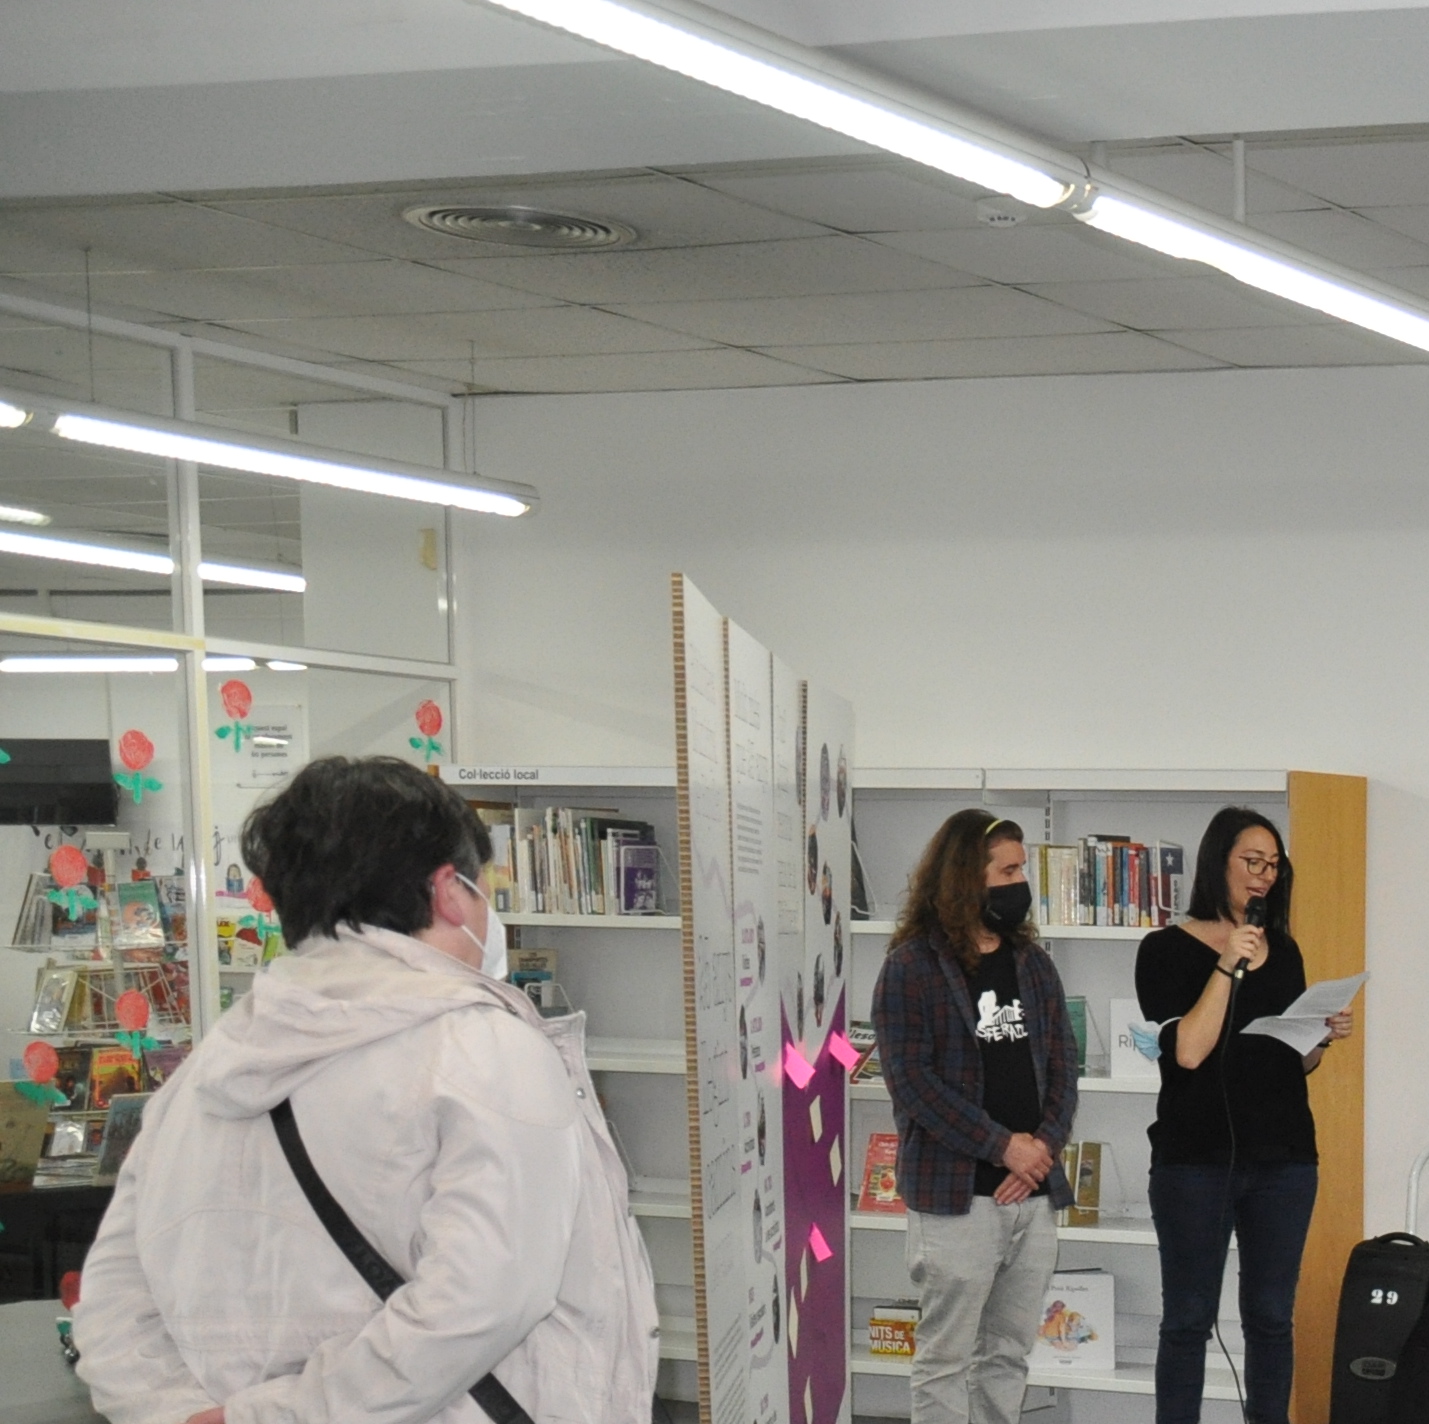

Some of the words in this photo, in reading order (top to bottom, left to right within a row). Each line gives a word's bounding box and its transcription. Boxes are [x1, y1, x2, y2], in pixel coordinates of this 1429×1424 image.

[458, 768, 511, 780] Col·lecció
[513, 769, 539, 780] local
[869, 1326, 893, 1340] NITS
